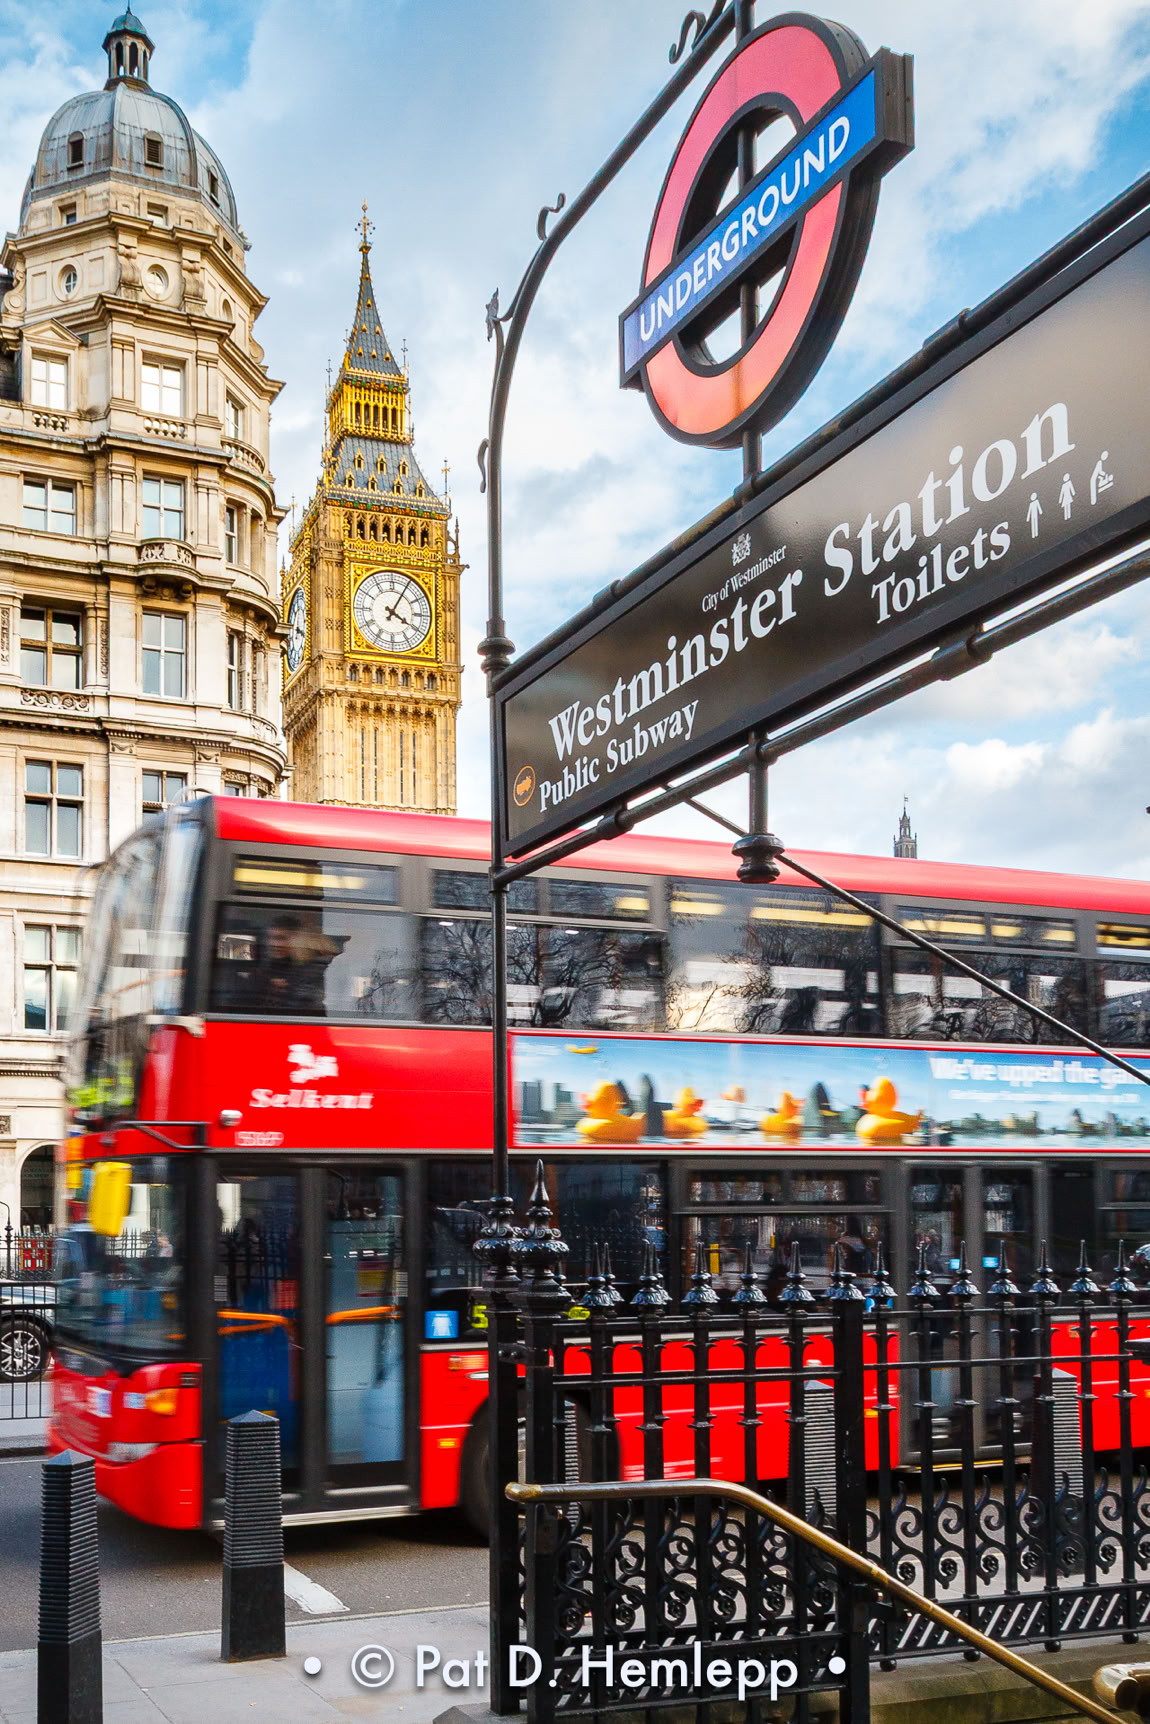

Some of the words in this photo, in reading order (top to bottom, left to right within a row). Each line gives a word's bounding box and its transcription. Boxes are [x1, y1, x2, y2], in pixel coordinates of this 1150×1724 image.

[639, 115, 850, 341] UNDERGROUND
[547, 569, 803, 762] Westminster
[823, 402, 1076, 597] Station
[702, 592, 719, 612] City
[720, 580, 730, 601] of
[730, 545, 787, 592] Westminster
[871, 521, 1010, 624] Toilets
[539, 756, 600, 812] Public
[606, 699, 699, 773] Subway
[249, 1088, 375, 1109] Selkent
